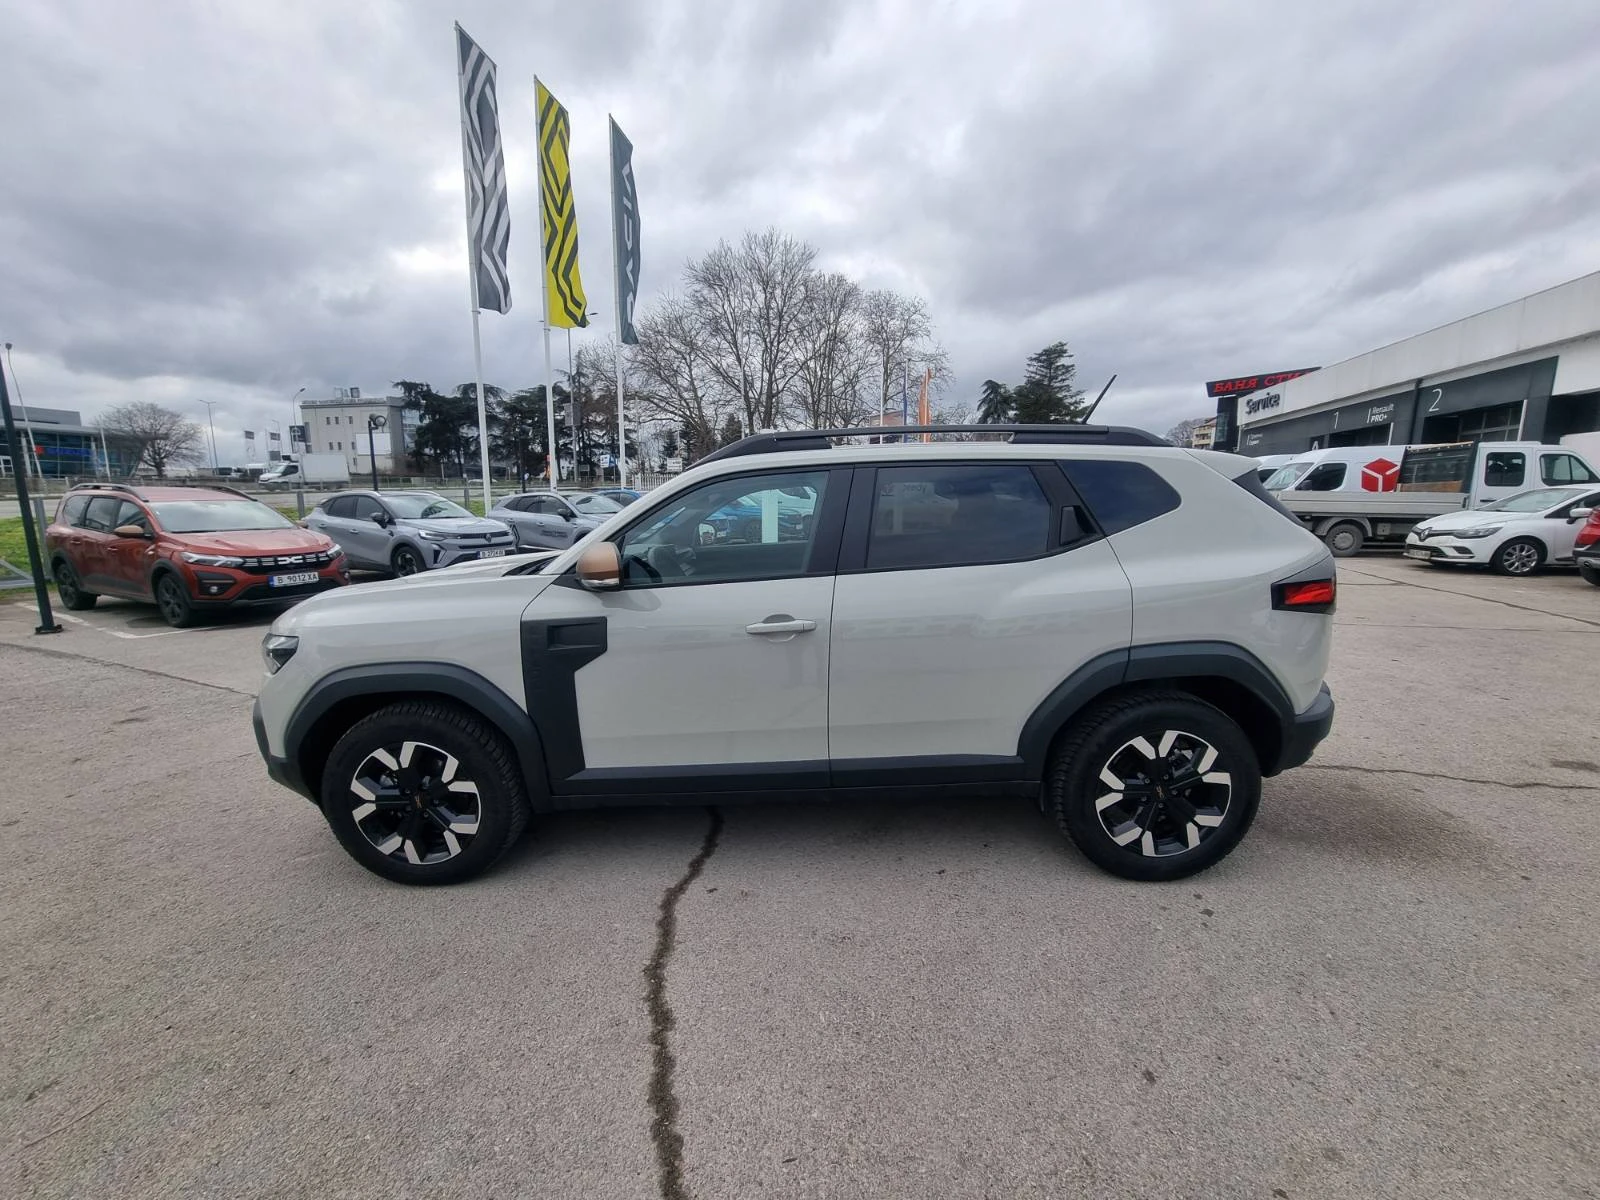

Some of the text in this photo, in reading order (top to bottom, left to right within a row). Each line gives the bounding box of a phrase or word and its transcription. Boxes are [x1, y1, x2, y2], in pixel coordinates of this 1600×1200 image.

[1214, 379, 1257, 392] БАНЯ
[1245, 392, 1281, 415] Service
[1428, 388, 1443, 412] 2
[1333, 411, 1339, 429] 1
[1370, 414, 1388, 423] PRO+
